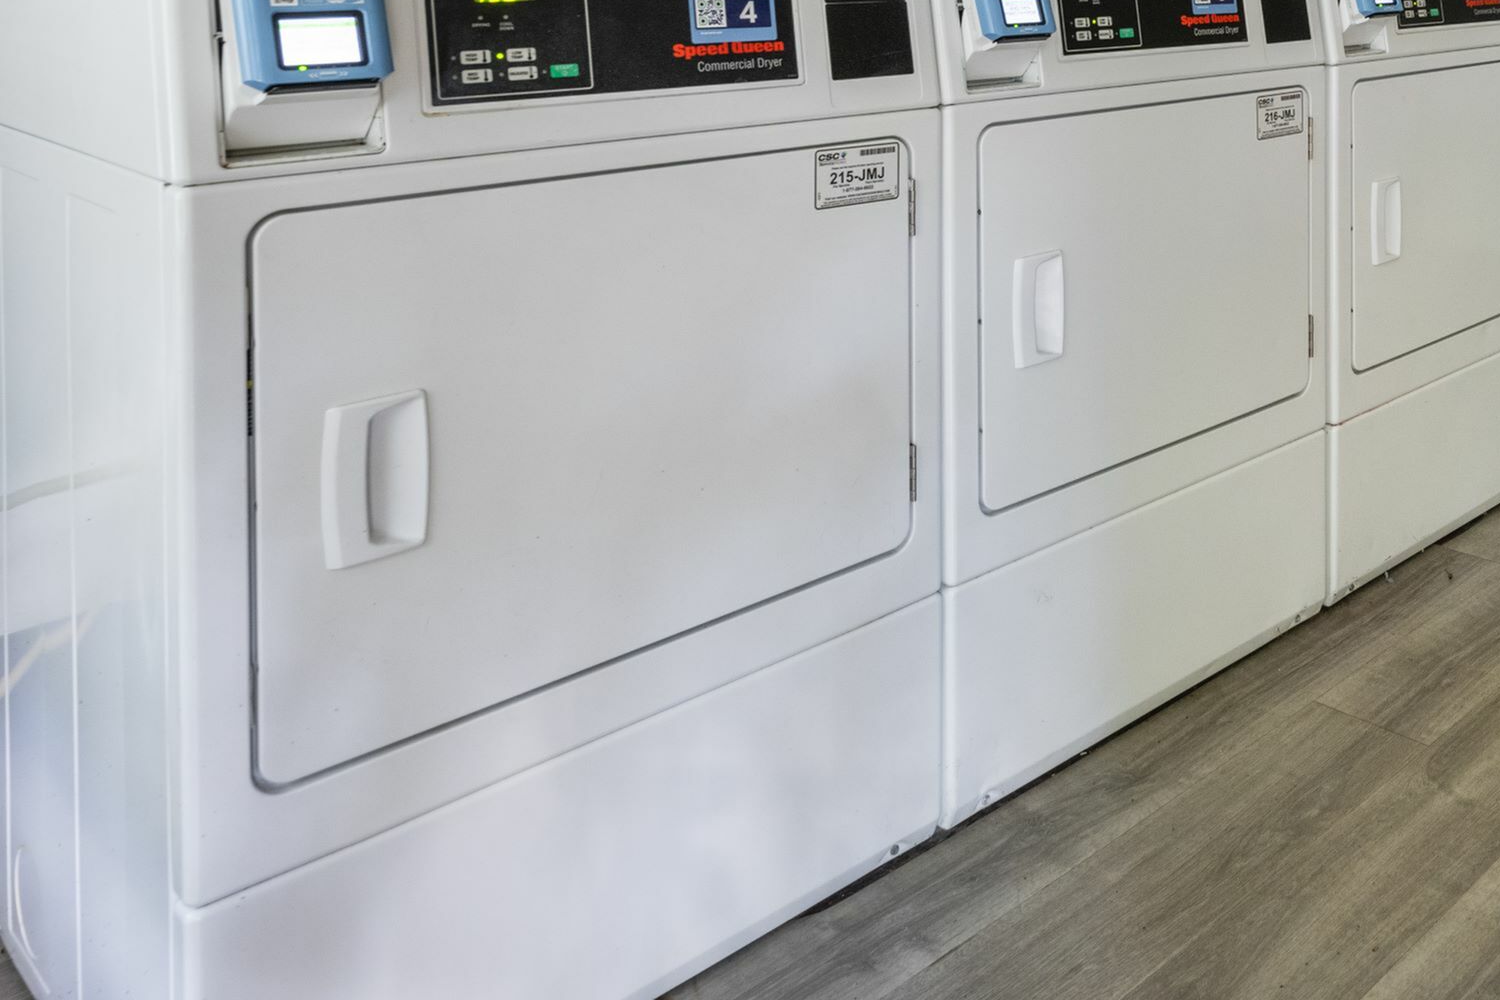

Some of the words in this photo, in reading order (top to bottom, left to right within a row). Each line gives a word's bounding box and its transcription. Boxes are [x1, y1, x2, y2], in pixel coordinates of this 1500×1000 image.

[739, 0, 758, 24] 4
[1180, 14, 1210, 27] Speed
[1211, 13, 1239, 23] Queen
[1194, 26, 1224, 36] Commercial
[1225, 26, 1239, 35] Dryer
[672, 42, 729, 60] Speed
[731, 40, 785, 54] Queen
[697, 58, 755, 72] Commercial
[757, 57, 783, 70] Dryer
[818, 152, 840, 162] CSC
[830, 166, 885, 185] 215-JMJ
